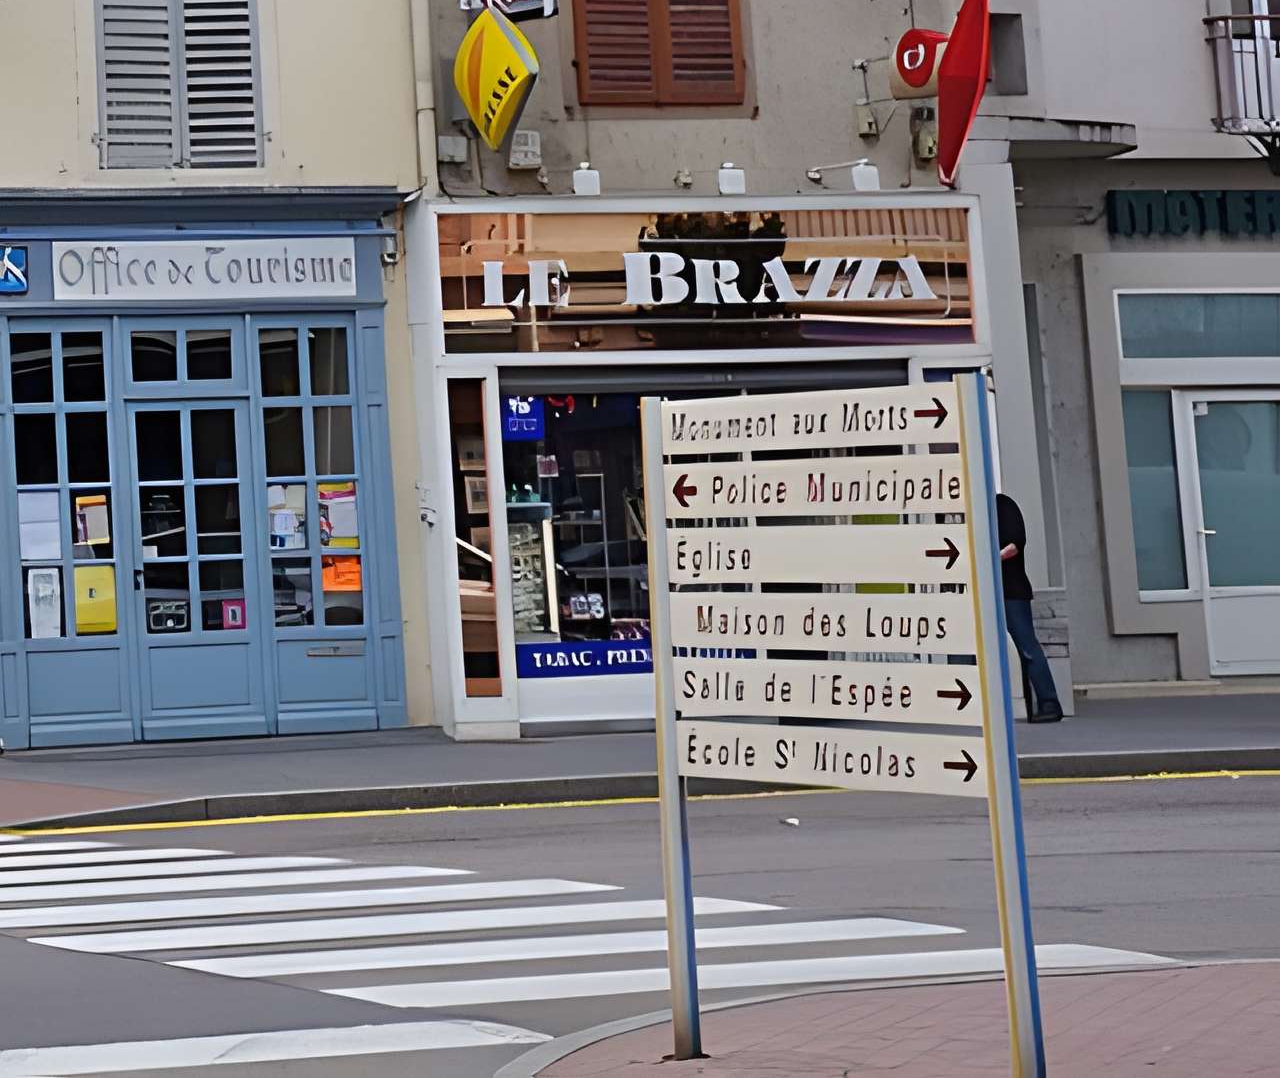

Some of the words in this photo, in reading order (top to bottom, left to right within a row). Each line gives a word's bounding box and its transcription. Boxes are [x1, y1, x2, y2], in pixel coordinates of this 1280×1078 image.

[58, 246, 157, 295] Office
[204, 246, 353, 285] Tourisme
[481, 258, 570, 308] LE
[622, 251, 939, 307] BRAZZA
[841, 402, 908, 434] Morts
[711, 473, 788, 504] Police
[806, 468, 961, 510] Municipale
[696, 605, 785, 635] Maison
[802, 606, 847, 637] des
[864, 607, 947, 646] Loups
[764, 673, 792, 703] de
[811, 673, 913, 714] l'Espée
[686, 728, 756, 767] École
[813, 741, 917, 778] Nicolas
